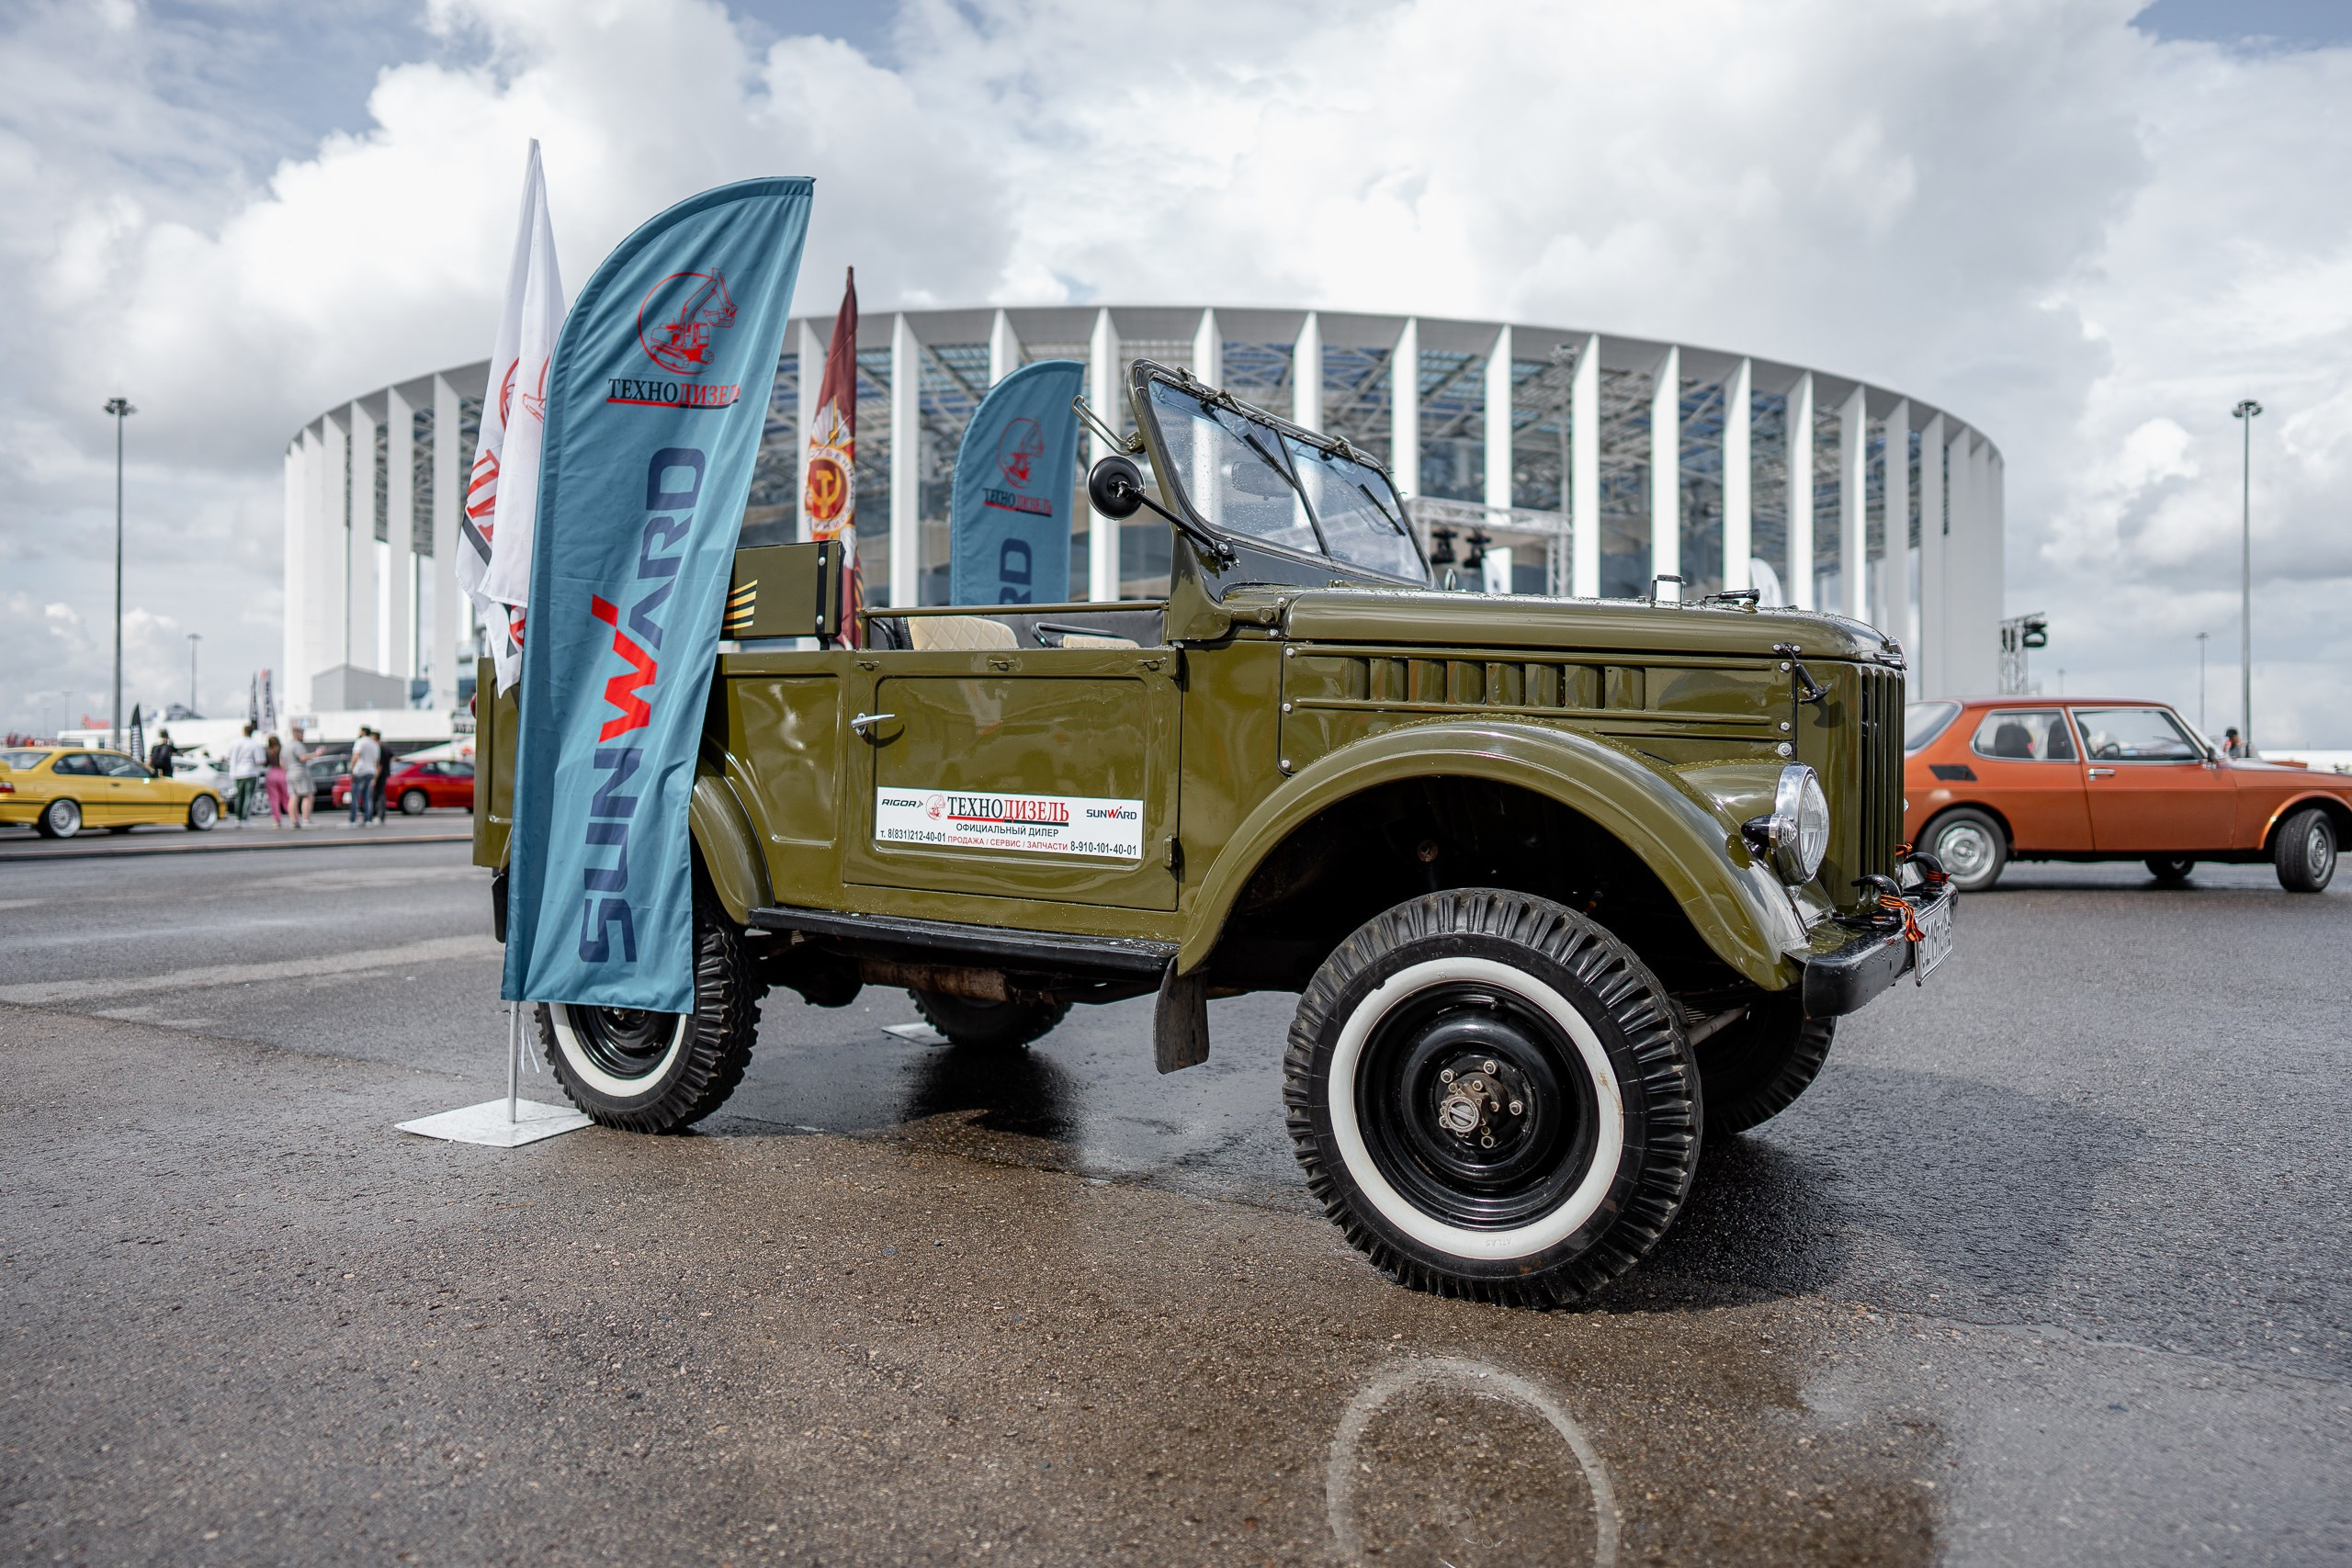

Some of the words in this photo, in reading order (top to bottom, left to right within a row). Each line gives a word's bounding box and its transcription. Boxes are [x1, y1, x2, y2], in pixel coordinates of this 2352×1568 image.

[579, 446, 707, 964] SUNWARD
[882, 798, 917, 807] RIGOR
[947, 795, 1069, 823] ТЕХНОДИЗЕЛЬ
[1086, 806, 1137, 820] SUNWARD
[888, 828, 945, 842] 8(831)212-40-01
[956, 823, 1026, 836] ОФИЦИАЛЬНЫЙ
[1028, 828, 1059, 838] ДИЛЕР
[947, 835, 984, 845] ПРОДАЖА
[989, 839, 1021, 848] СЕРВИС
[1026, 840, 1069, 851] ЗАПЧАСТИ
[1070, 840, 1136, 855] 8-910-101-40-01
